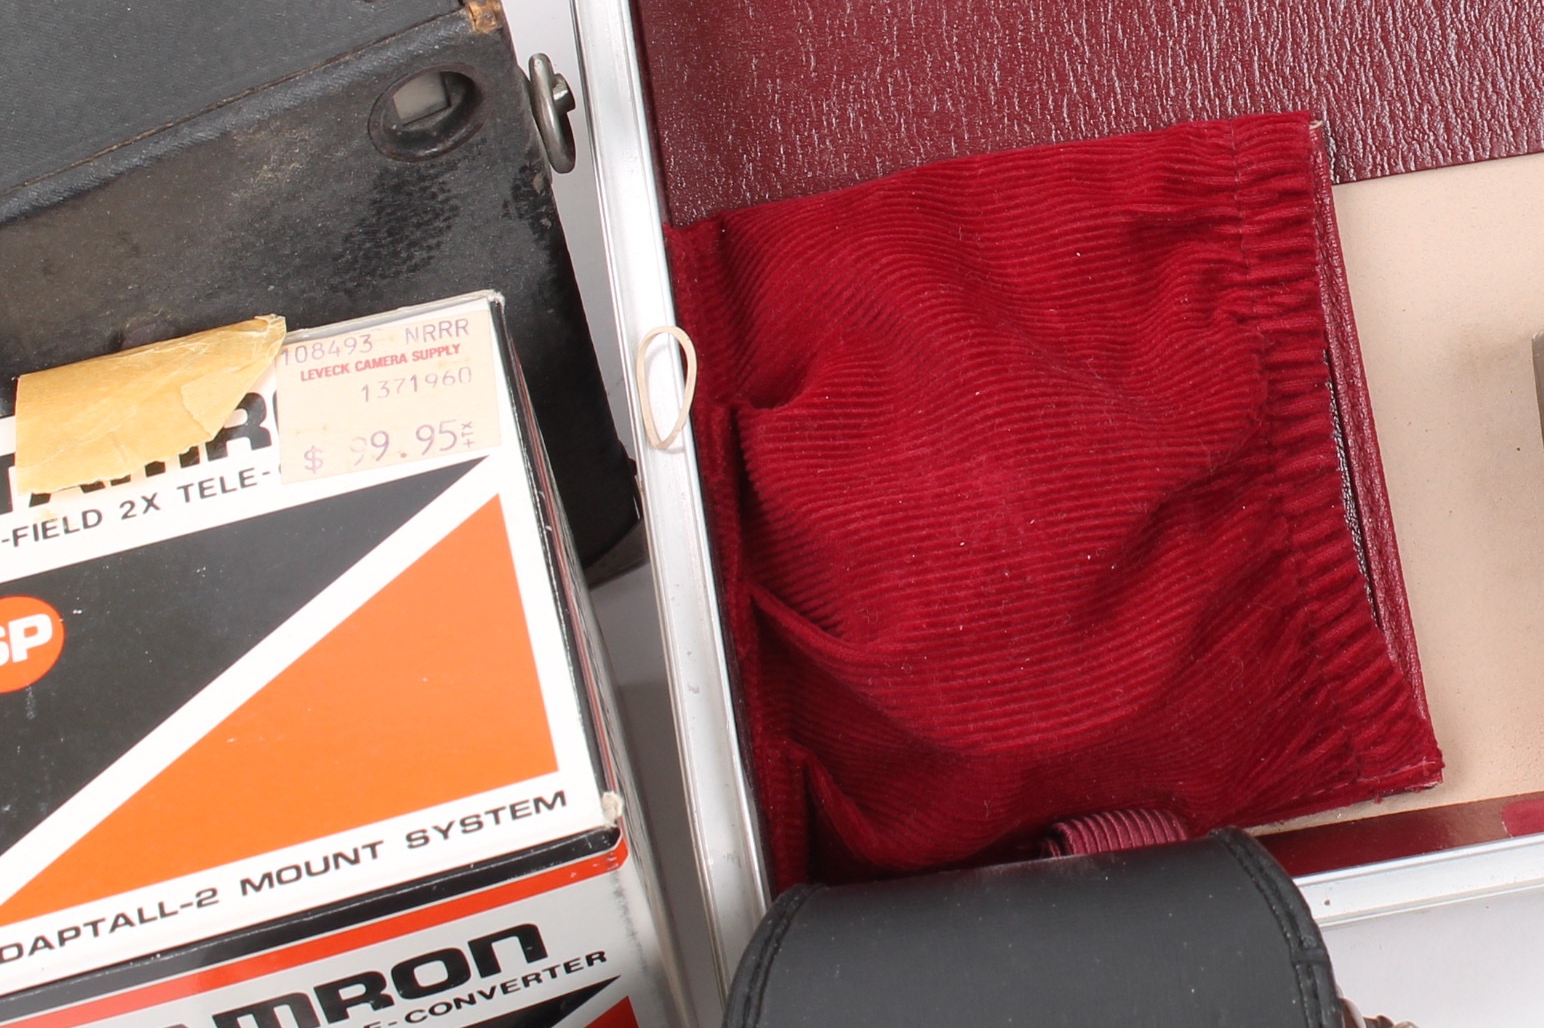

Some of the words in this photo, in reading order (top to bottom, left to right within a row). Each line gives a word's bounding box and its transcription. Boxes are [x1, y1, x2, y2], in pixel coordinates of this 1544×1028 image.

[280, 334, 374, 366] 108493
[405, 318, 470, 345] NRRR
[300, 363, 350, 382] LEVECK
[355, 353, 407, 372] CAMERA
[412, 343, 461, 362] SUPPLY
[361, 365, 472, 403] 1371960
[119, 492, 161, 520] 2X
[176, 466, 282, 503] TELE-
[0, 613, 53, 668] P
[239, 840, 384, 897] MOUNT
[405, 790, 568, 851] SYSTEM
